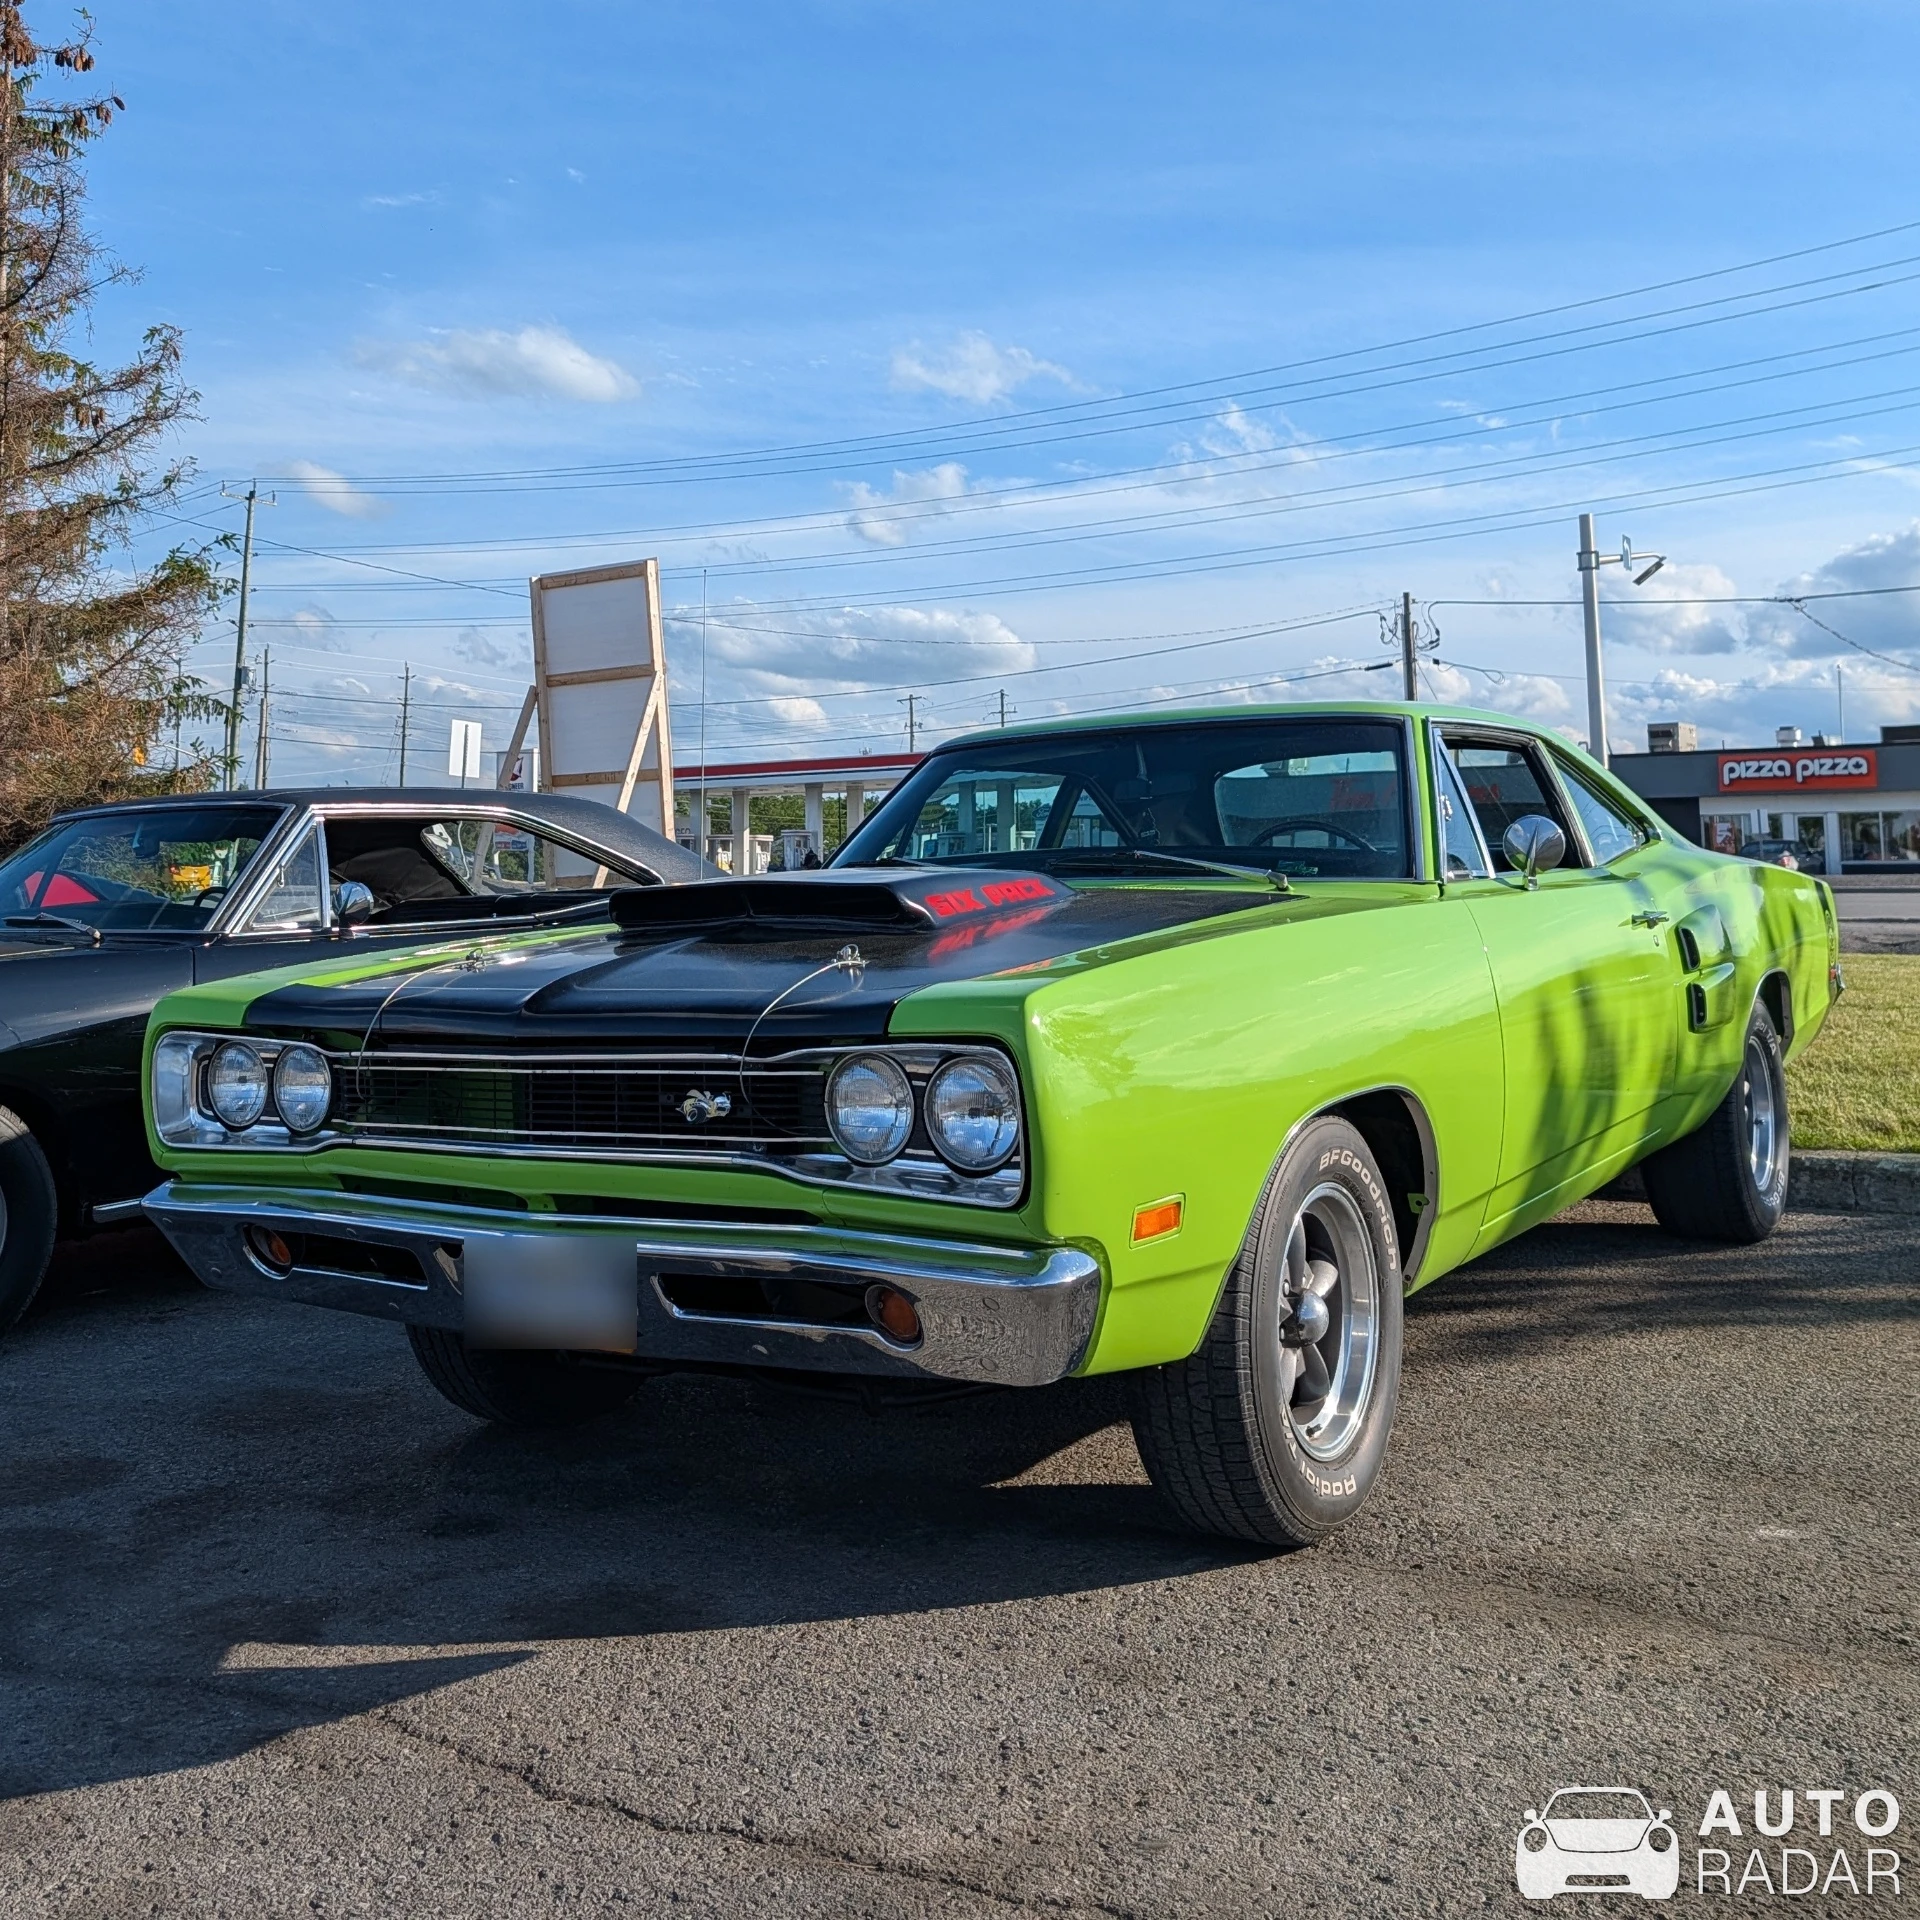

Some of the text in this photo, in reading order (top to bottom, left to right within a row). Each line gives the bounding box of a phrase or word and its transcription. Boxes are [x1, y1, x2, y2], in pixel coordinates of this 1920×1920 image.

[1723, 757, 1867, 785] pizza pizza
[925, 878, 1056, 917] SIX PACK
[1319, 1149, 1397, 1270] BFGoodrich
[1299, 1461, 1357, 1497] Radial
